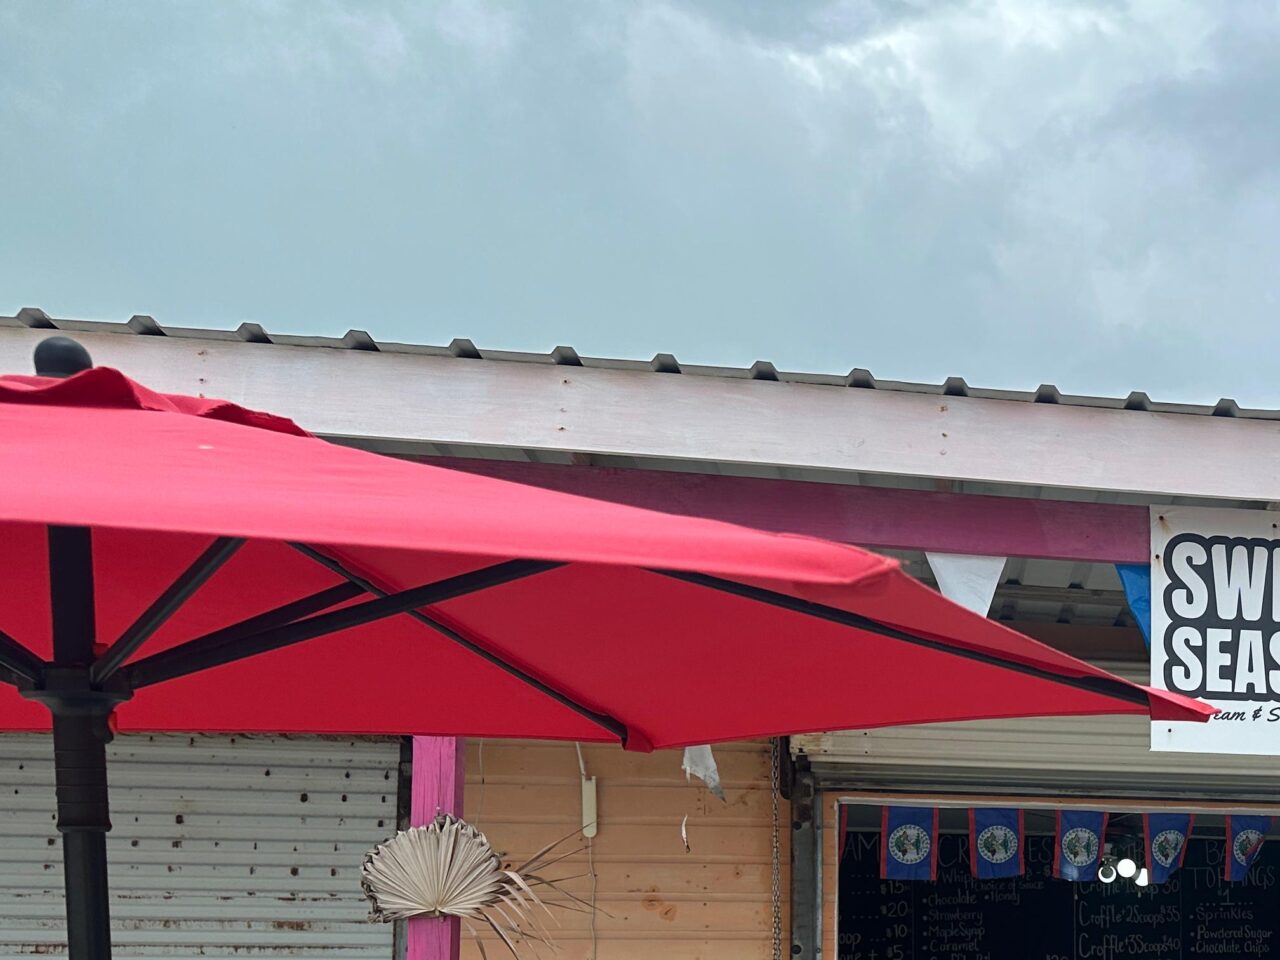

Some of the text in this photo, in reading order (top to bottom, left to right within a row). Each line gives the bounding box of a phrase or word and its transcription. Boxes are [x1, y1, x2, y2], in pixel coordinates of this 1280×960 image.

[1252, 705, 1262, 722] &
[928, 890, 977, 906] Chocolate
[928, 909, 983, 927] Strawberry
[1244, 924, 1273, 943] Sugar
[929, 939, 981, 952] Caramel
[1196, 940, 1270, 958] Chocolate Chips
